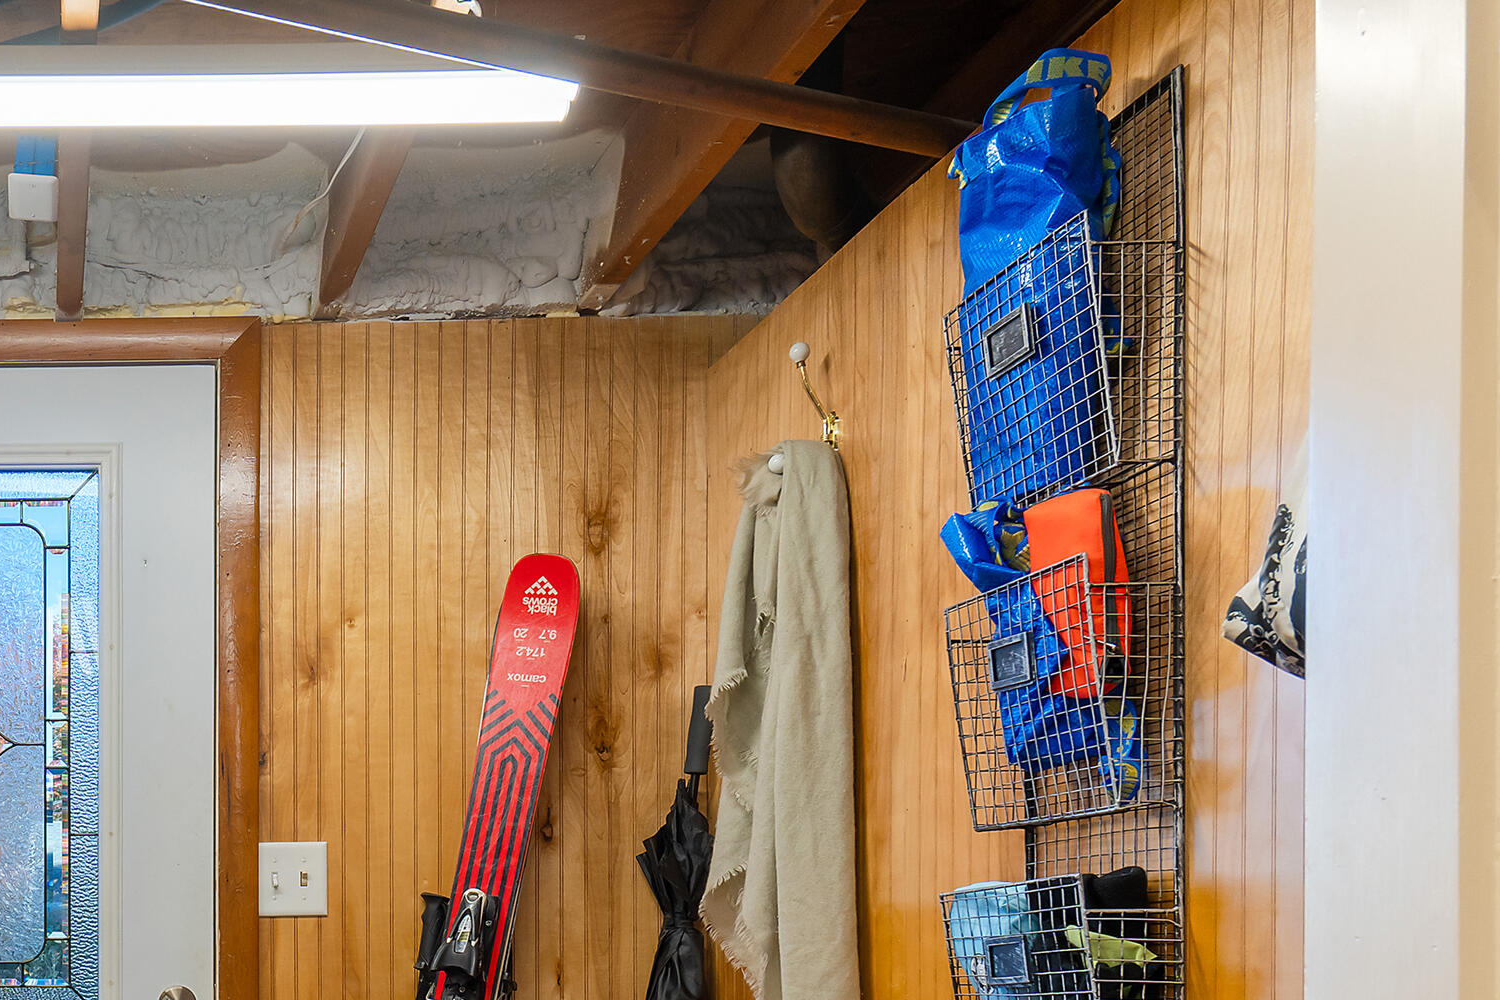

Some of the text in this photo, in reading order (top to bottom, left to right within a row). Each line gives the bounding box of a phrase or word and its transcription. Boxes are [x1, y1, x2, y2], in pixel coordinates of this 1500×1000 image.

[522, 597, 558, 606] crows
[527, 604, 557, 616] black
[514, 627, 557, 640] 9.7 20
[516, 646, 545, 657] 174.2
[507, 673, 546, 683] camox
